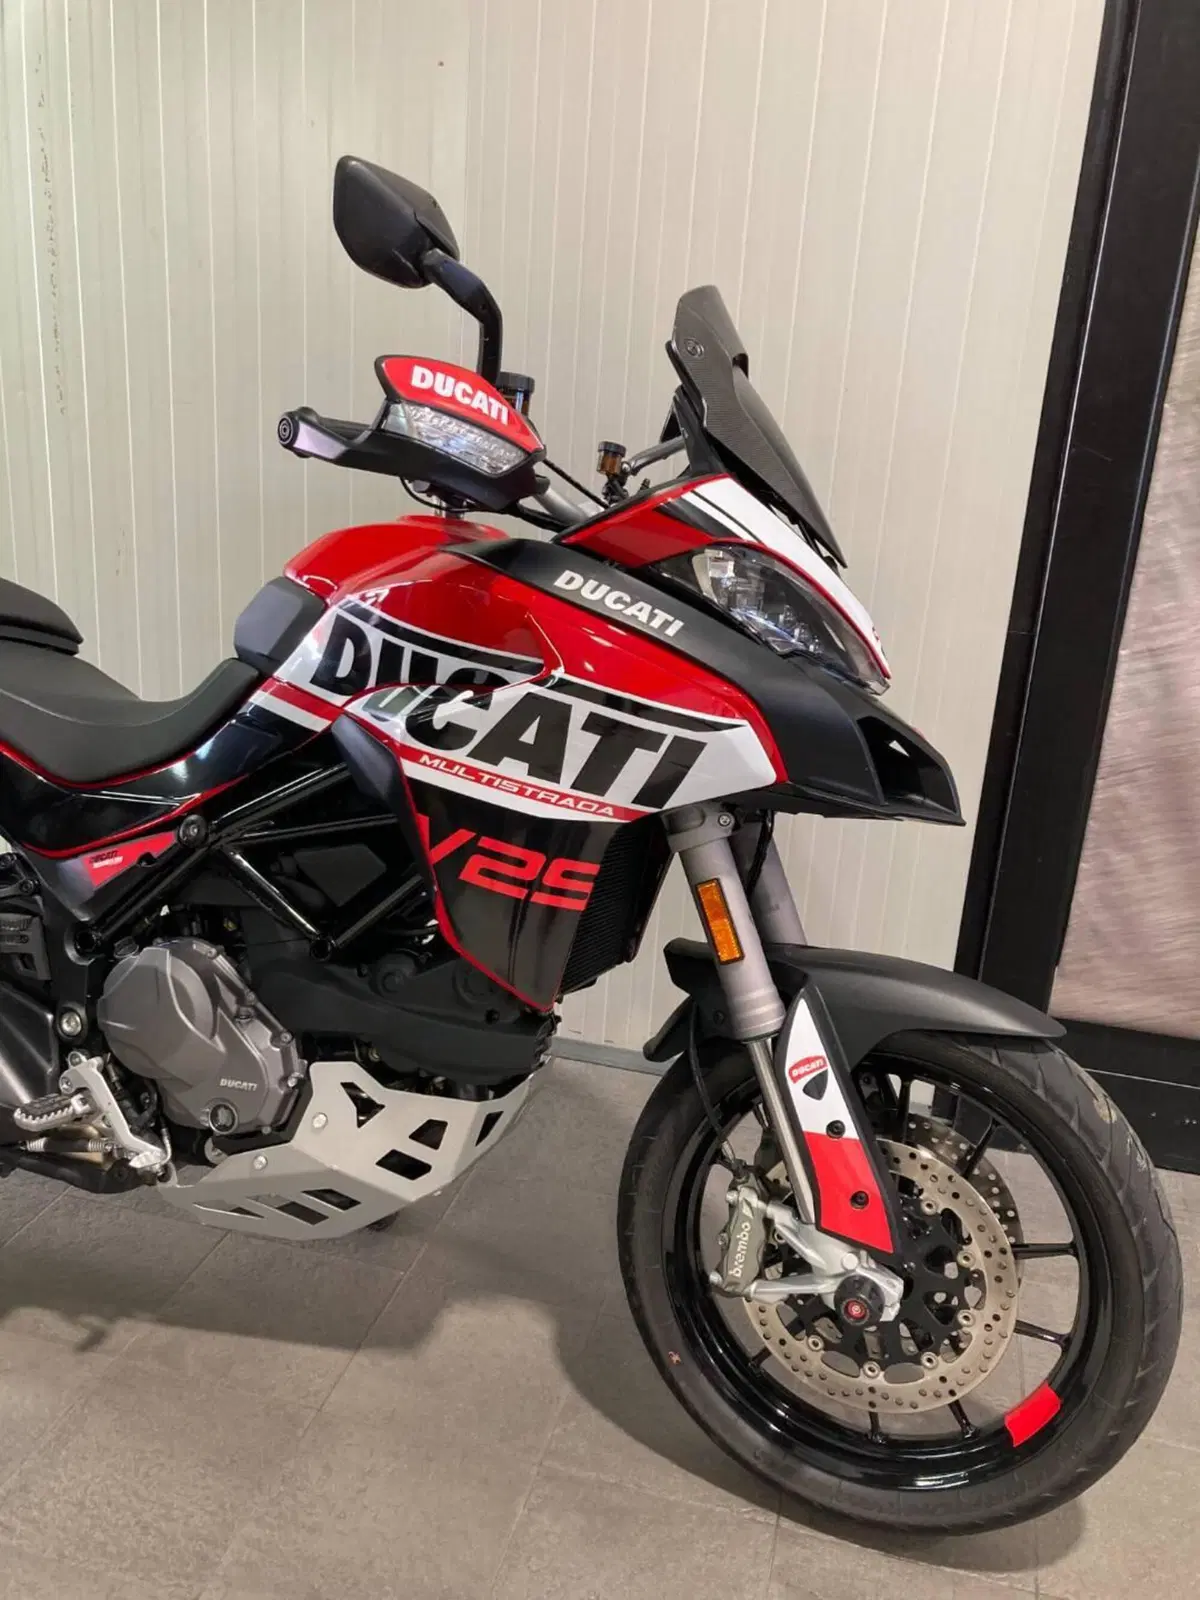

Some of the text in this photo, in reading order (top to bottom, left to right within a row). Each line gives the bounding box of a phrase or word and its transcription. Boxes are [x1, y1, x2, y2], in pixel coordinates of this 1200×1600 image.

[410, 364, 509, 425] DUCATI
[553, 569, 685, 637] DUCATI
[309, 612, 708, 810] DUCATI
[418, 753, 615, 818] MULTISTRADA
[219, 1077, 258, 1092] DUCATI
[791, 1059, 824, 1077] DUCATI
[728, 1221, 752, 1278] brembo
